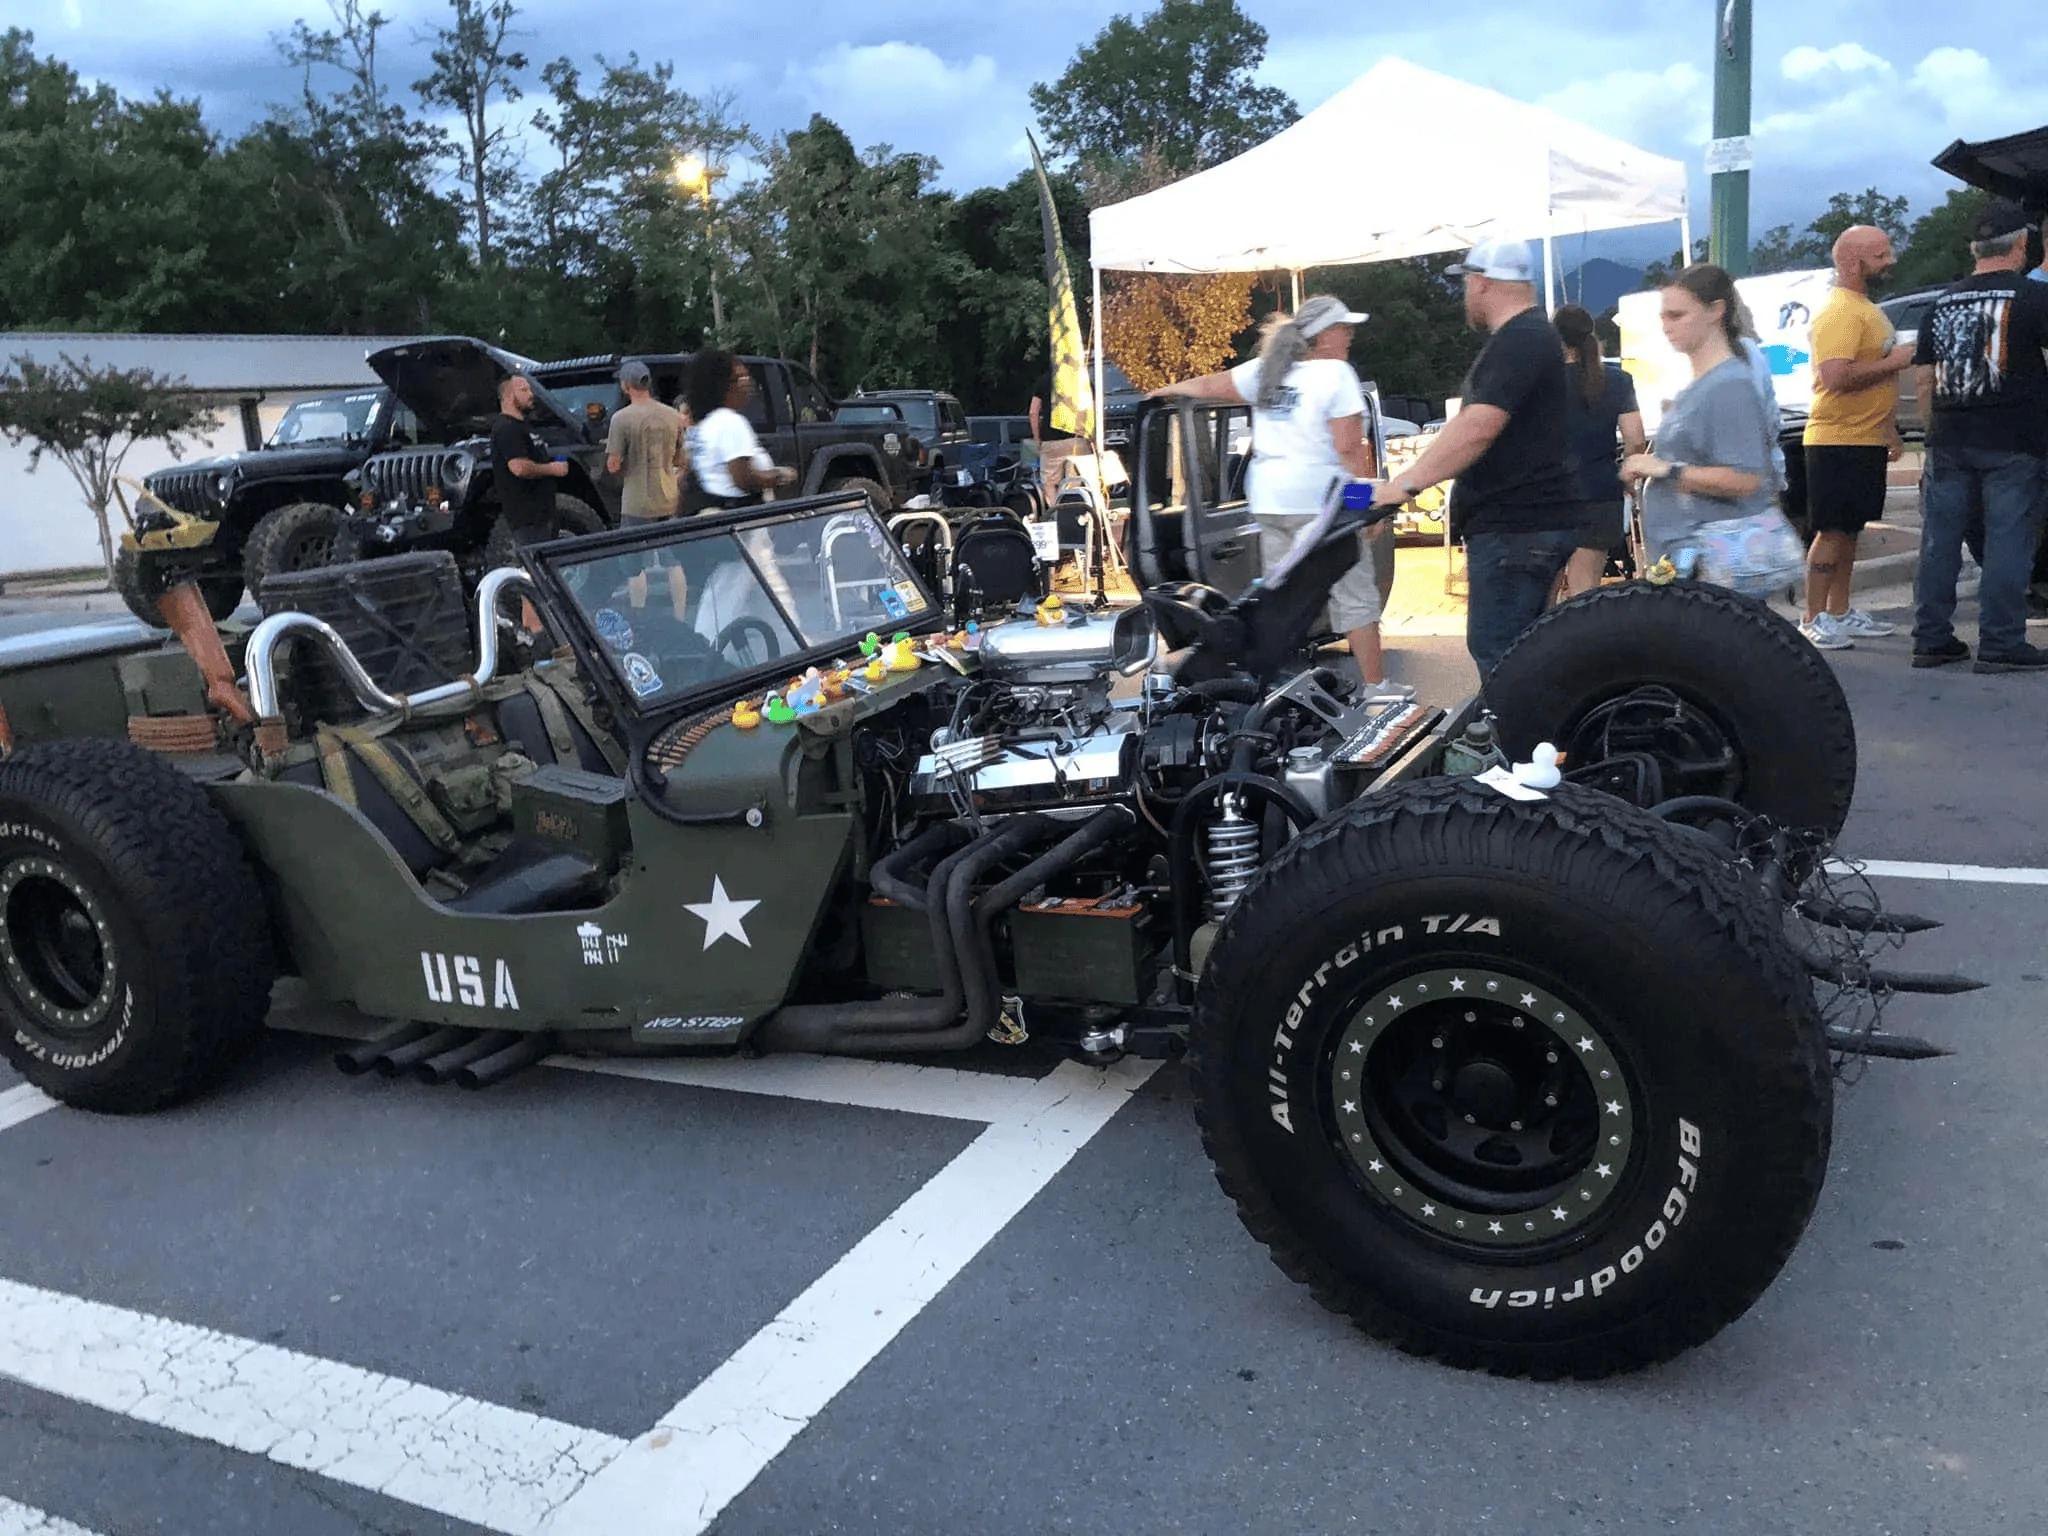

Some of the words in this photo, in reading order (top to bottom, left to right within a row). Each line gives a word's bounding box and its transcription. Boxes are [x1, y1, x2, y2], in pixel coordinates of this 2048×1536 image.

[420, 951, 520, 1011] USA
[15, 1030, 46, 1060] T/A
[52, 982, 133, 1070] All-Terrain
[643, 1017, 682, 1029] NO
[682, 1016, 744, 1028] STEP
[1269, 924, 1404, 1135] All-Terrain
[1421, 913, 1501, 937] T/A
[1469, 1117, 1701, 1309] BFGoodrich
